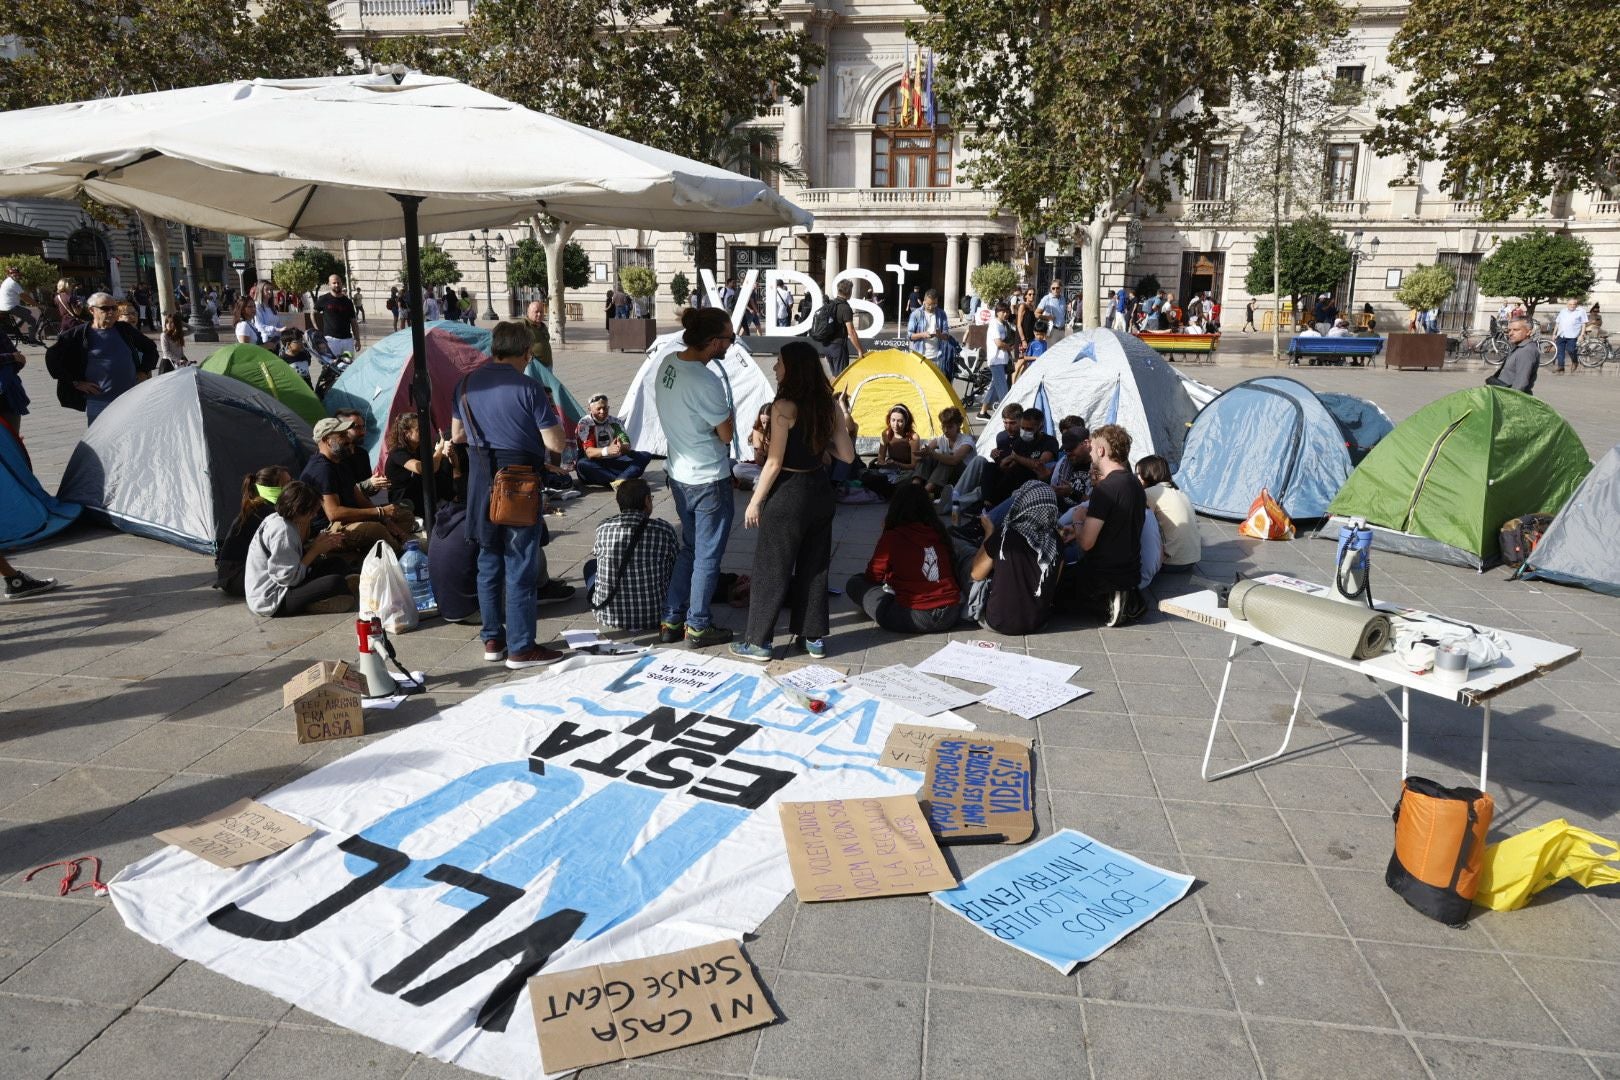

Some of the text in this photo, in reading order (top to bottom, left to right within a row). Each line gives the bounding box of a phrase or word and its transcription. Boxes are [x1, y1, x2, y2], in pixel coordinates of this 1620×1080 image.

[700, 268, 884, 339] VDS
[681, 667, 721, 679] justos
[303, 710, 325, 724] ERA
[307, 720, 353, 739] CASA
[622, 706, 763, 755] EN
[930, 741, 968, 832] PROU D'ESPECULAR
[961, 744, 994, 824] AMB LES NOSTRES
[989, 759, 1024, 813] VIDES!!
[795, 804, 846, 899] NO VOLEM AJUDES
[832, 820, 857, 841] BON
[842, 842, 864, 857] UN
[894, 815, 939, 877] DEL LLOGUER
[849, 861, 880, 895] VOLEM
[883, 860, 907, 876] LA
[951, 855, 1088, 922] INTERVENIR
[983, 862, 1135, 940] DEL ALQUILER
[1062, 889, 1149, 940] BONOS
[207, 834, 586, 1033] VLC
[542, 955, 743, 1022] SENSE GENT
[591, 994, 753, 1042] NI CASA
